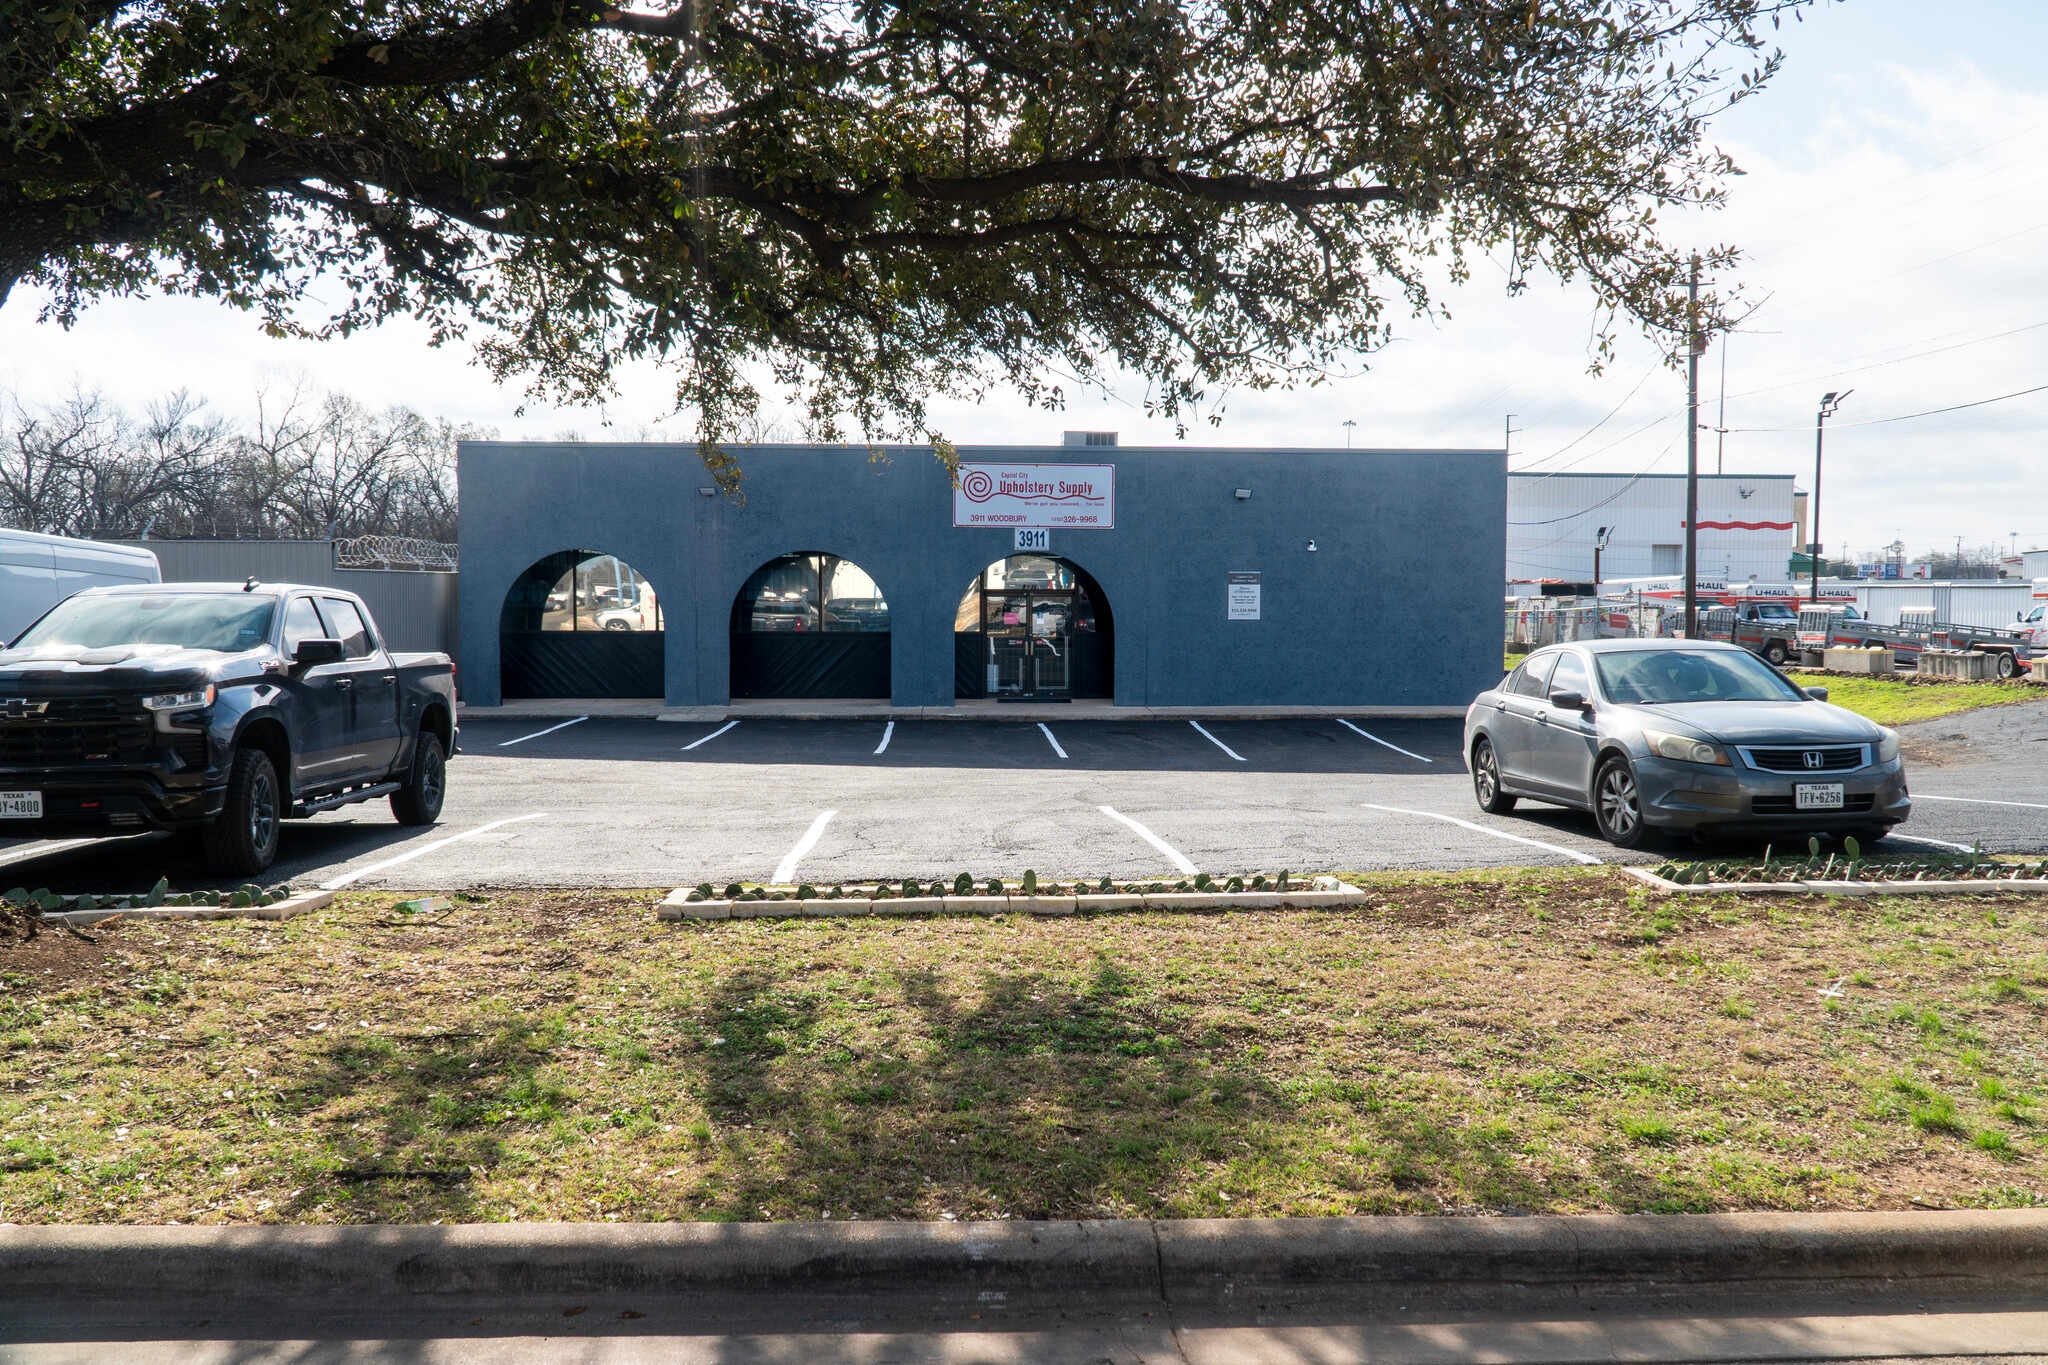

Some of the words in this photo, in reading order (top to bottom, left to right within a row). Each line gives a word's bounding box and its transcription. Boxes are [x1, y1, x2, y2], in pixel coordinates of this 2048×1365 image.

[999, 480, 1054, 495] Upholstery
[1058, 481, 1092, 496] Supply
[970, 514, 985, 522] 3911
[987, 514, 1027, 522] WOODBURY
[1018, 530, 1045, 547] 3911
